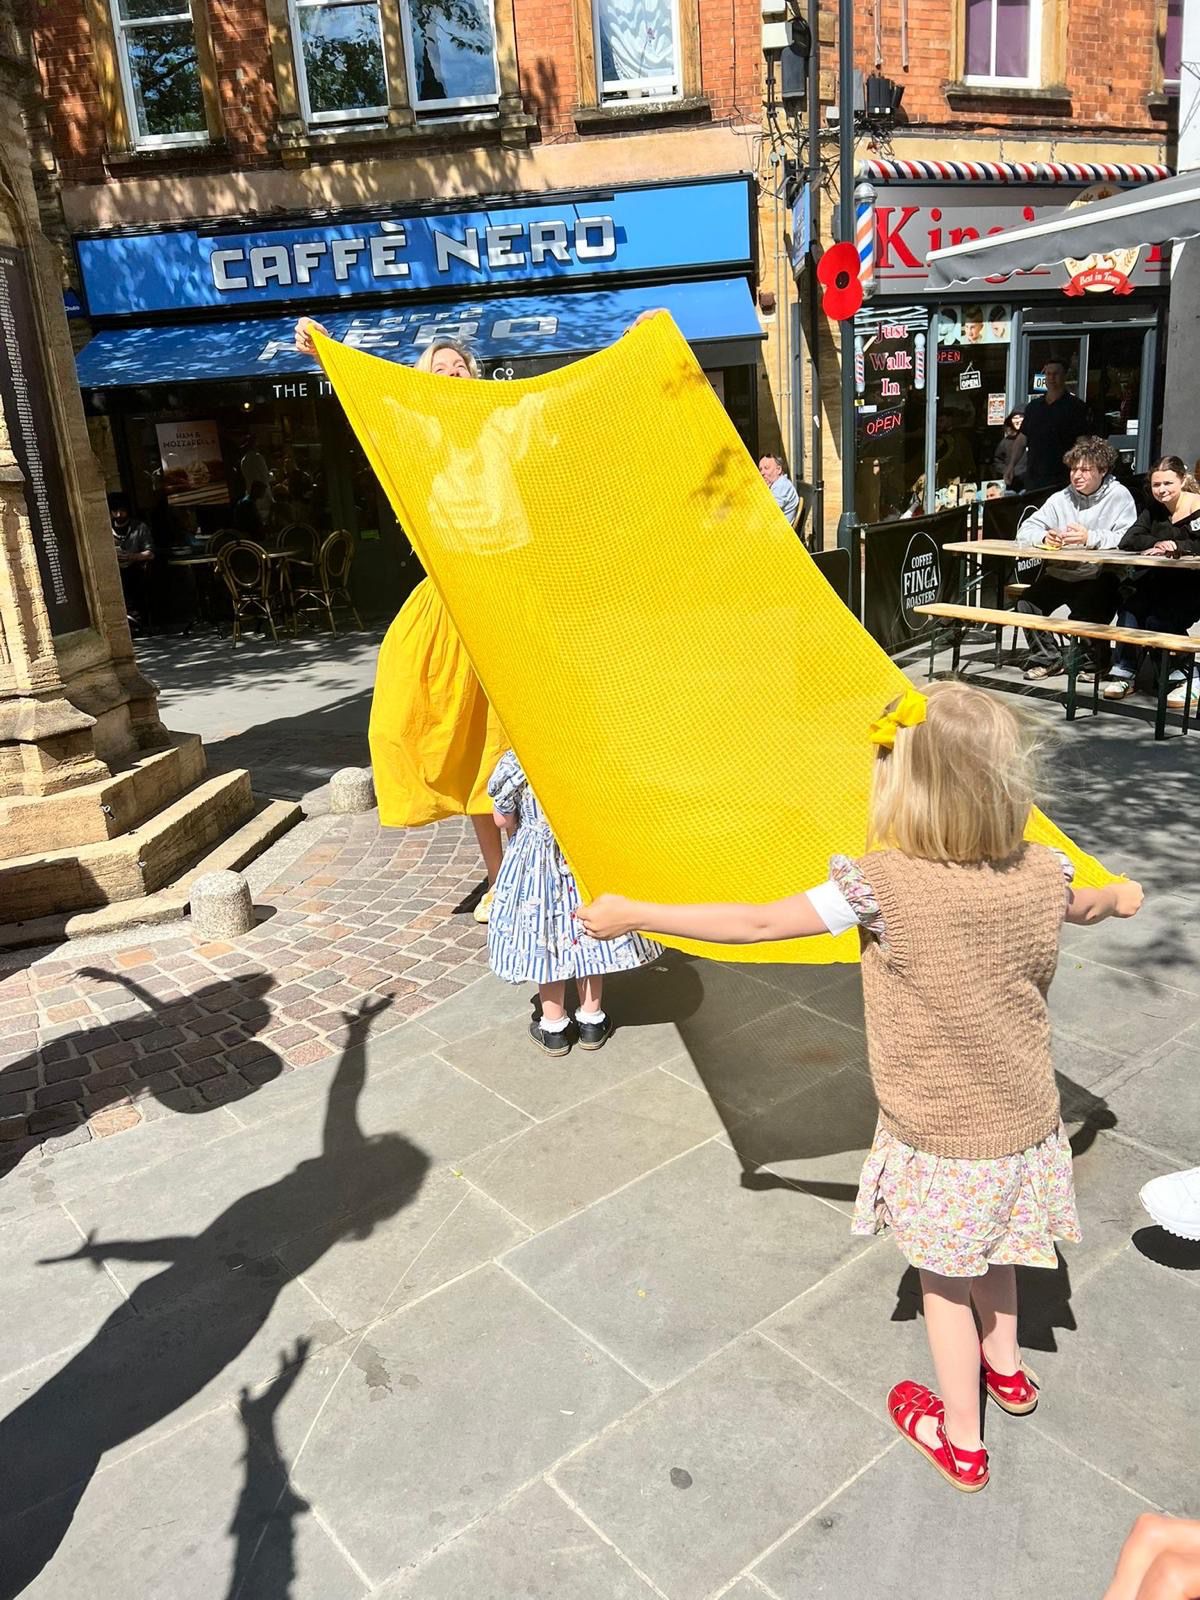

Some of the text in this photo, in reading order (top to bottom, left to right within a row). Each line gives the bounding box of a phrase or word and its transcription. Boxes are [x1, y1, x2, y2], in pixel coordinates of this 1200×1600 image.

[211, 216, 616, 290] CAFFÈ NERO
[1095, 272, 1103, 280] in
[874, 321, 908, 344] Just
[869, 351, 912, 371] Walk
[273, 383, 308, 399] THE
[881, 378, 900, 396] In
[961, 379, 979, 389] OPEN
[866, 413, 902, 435] OPEN
[911, 553, 933, 569] COFFEE
[903, 565, 938, 596] FINCA
[906, 590, 936, 610] ROASTERS
